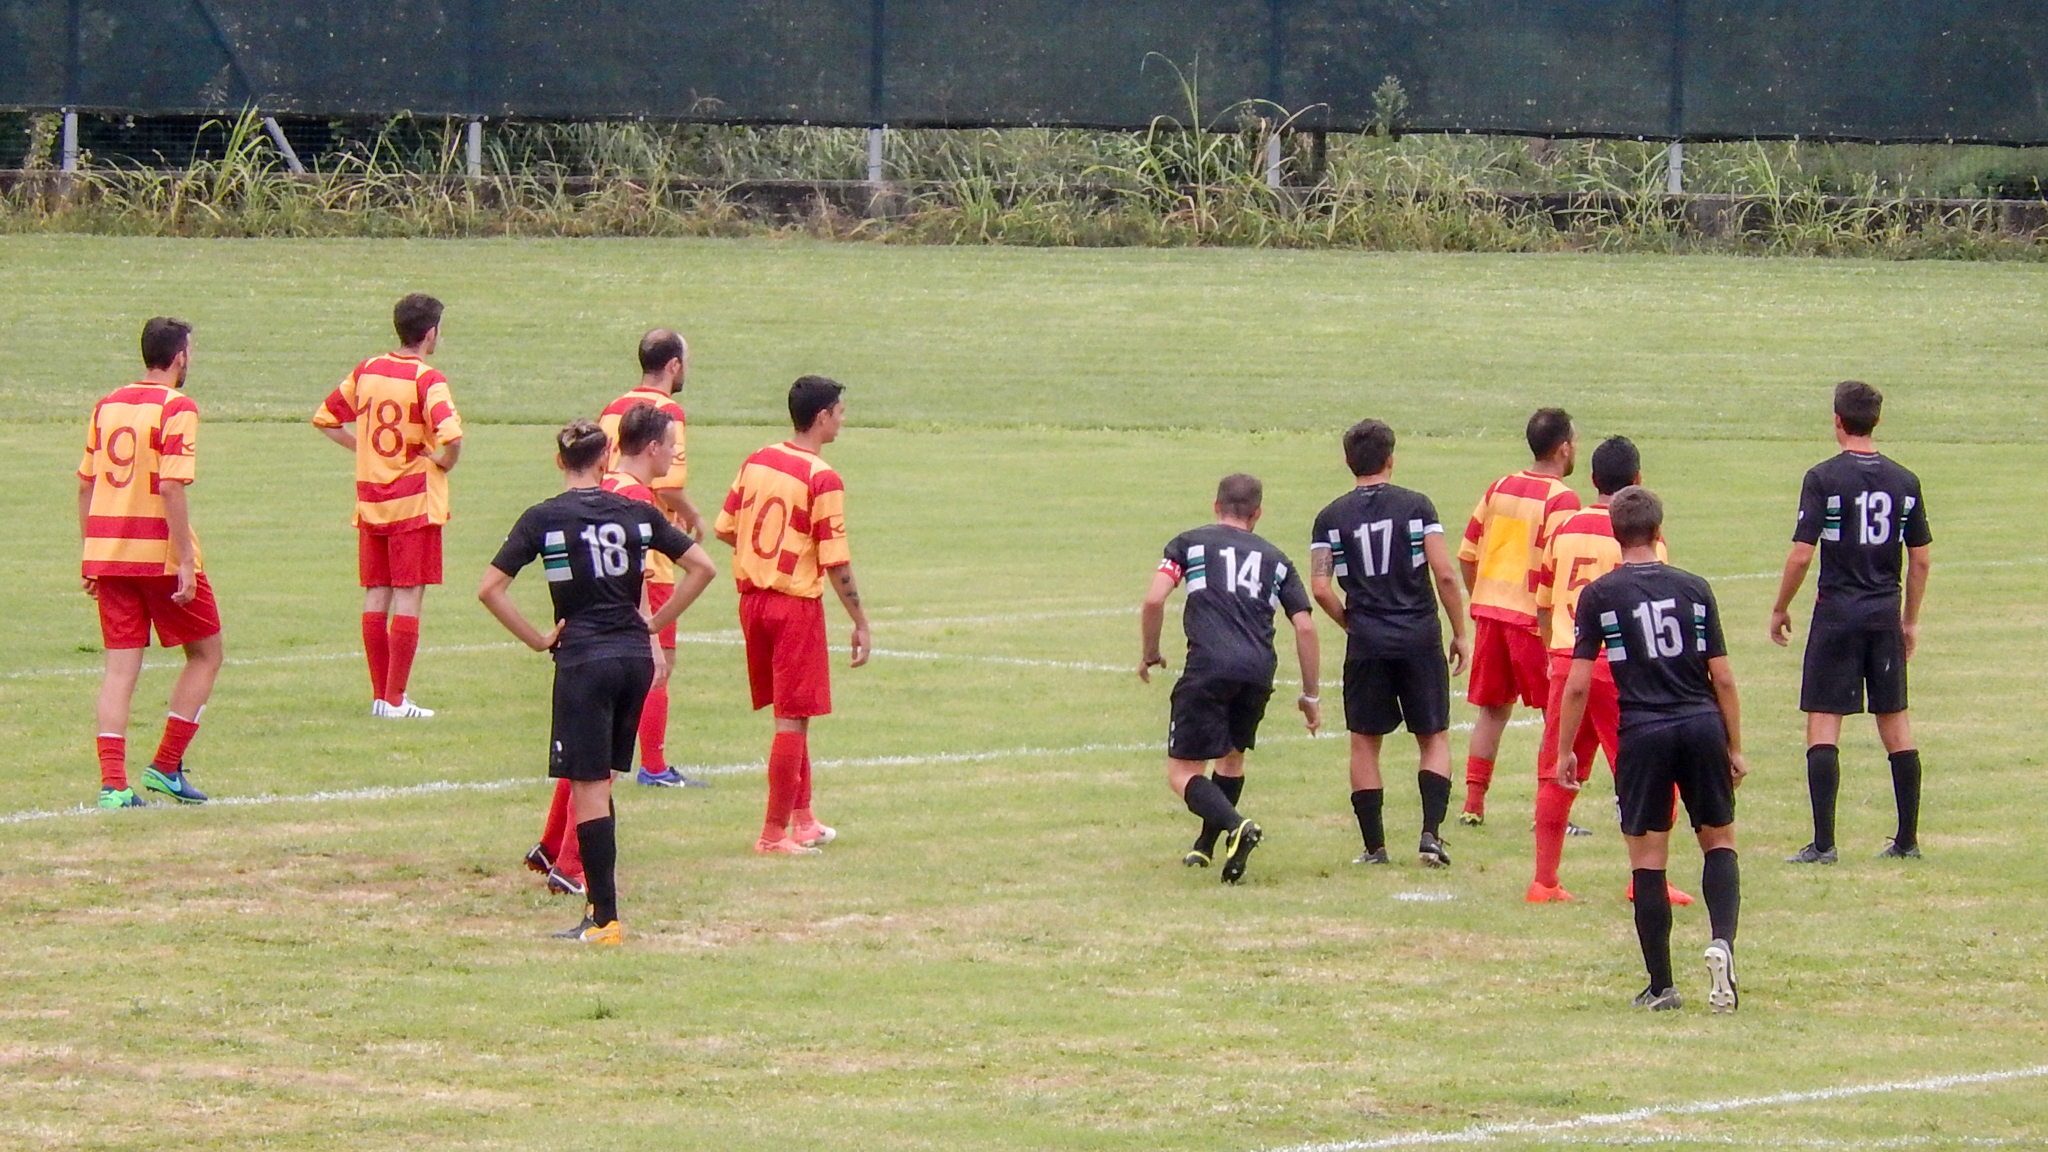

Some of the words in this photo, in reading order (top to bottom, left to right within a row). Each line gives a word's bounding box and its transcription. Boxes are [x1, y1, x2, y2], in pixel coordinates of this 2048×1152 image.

[106, 426, 138, 488] 9
[356, 396, 404, 458] 18
[1353, 518, 1393, 577] 17
[1855, 490, 1893, 545] 13
[580, 522, 630, 579] 18
[1219, 546, 1263, 599] 14
[1566, 557, 1598, 620] 5
[1632, 598, 1684, 659] 15
